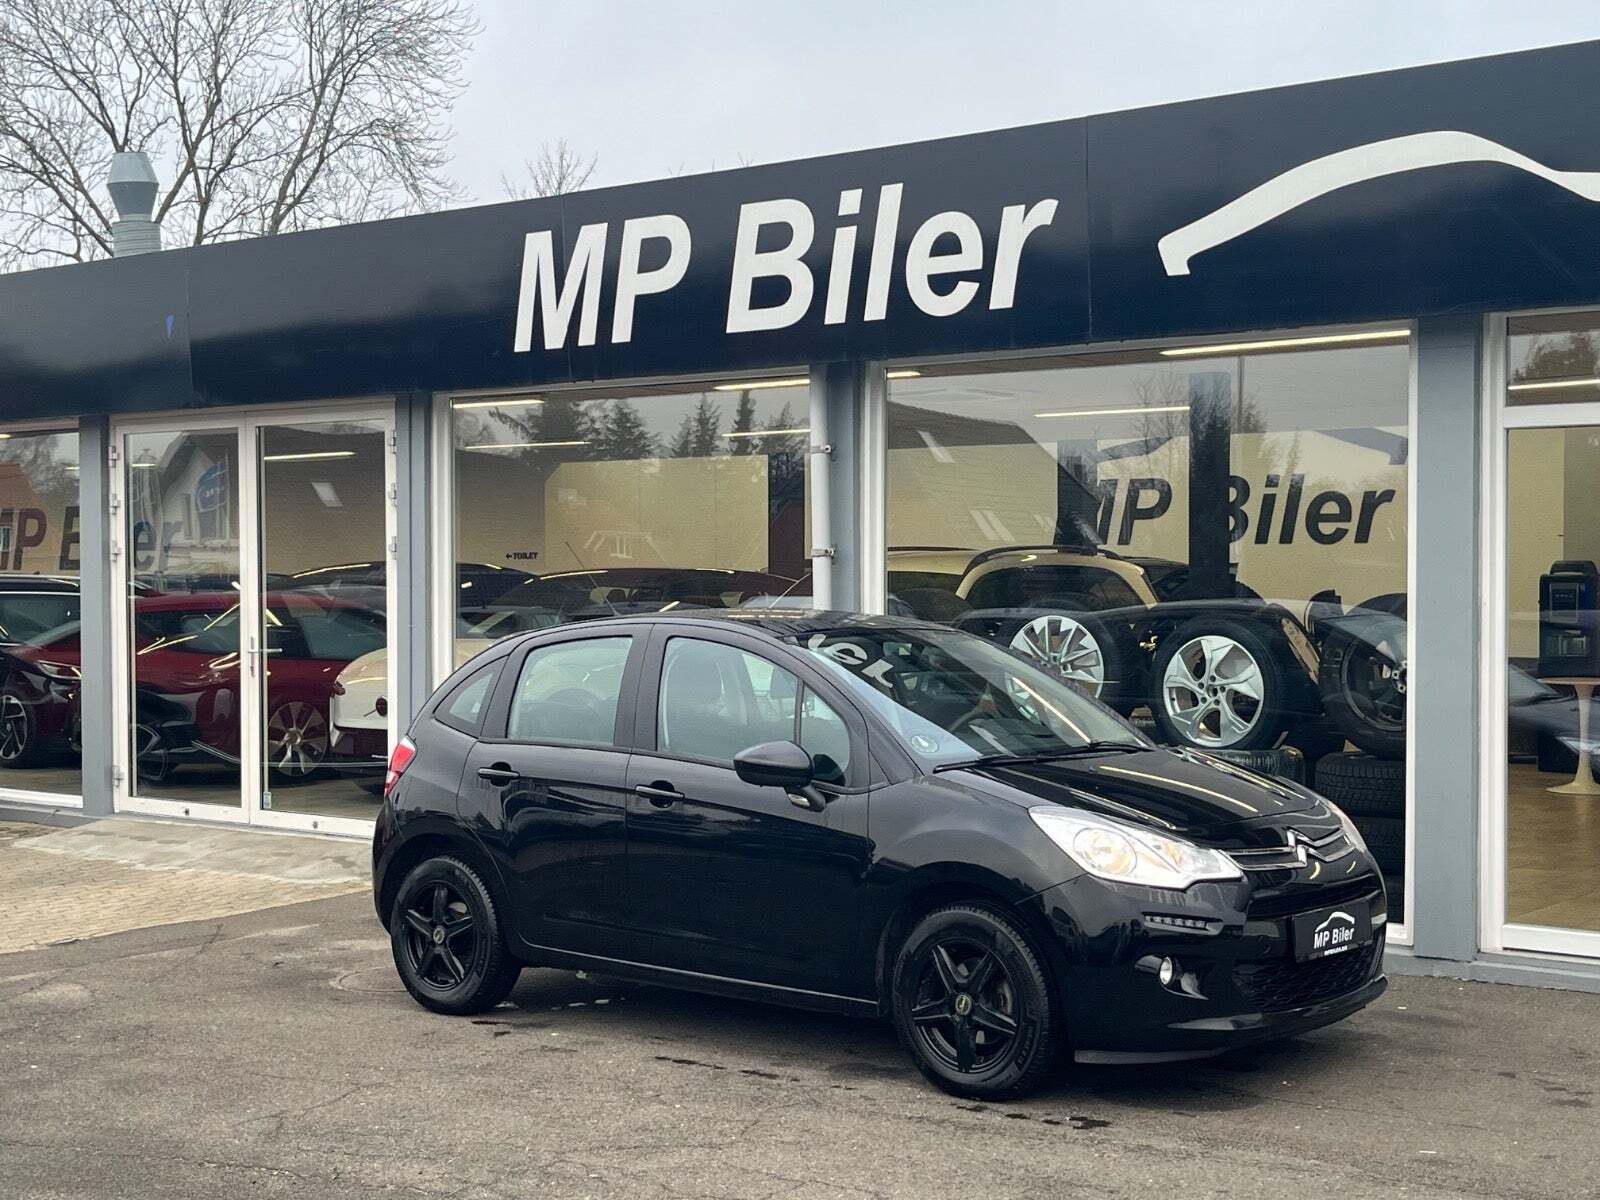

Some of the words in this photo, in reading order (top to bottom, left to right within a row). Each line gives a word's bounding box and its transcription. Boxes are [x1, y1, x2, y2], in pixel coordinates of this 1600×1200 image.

[514, 214, 691, 352] MP
[726, 182, 1058, 334] Biler
[513, 552, 538, 560] TOILET
[1314, 931, 1330, 948] MP
[1332, 927, 1354, 944] Biler
